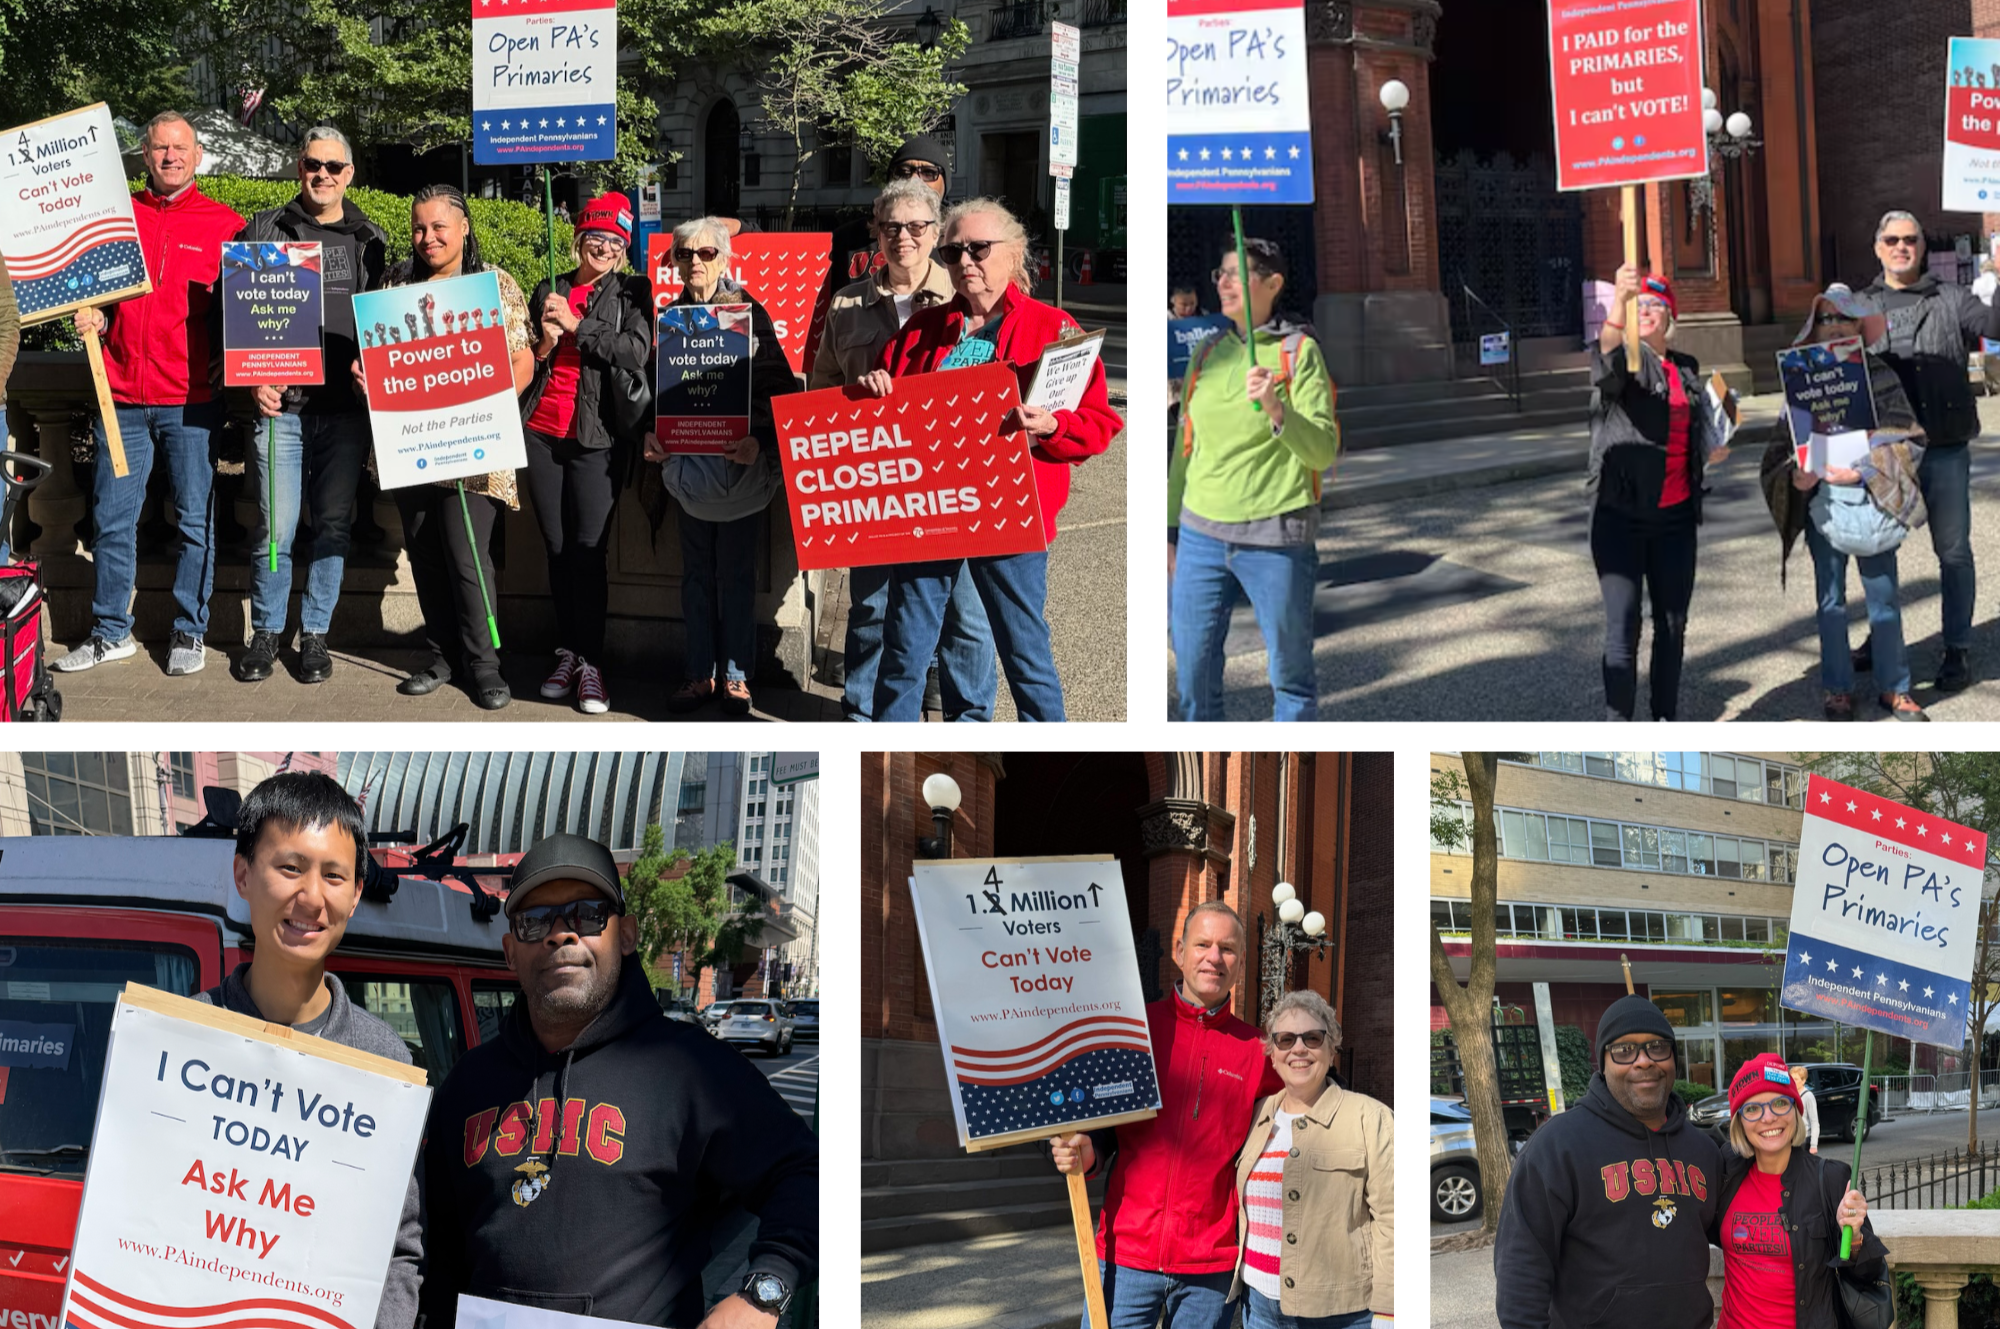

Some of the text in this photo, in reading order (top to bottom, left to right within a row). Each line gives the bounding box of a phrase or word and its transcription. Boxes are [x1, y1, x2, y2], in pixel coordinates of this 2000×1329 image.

[526, 17, 556, 25] Parties:
[489, 24, 600, 64] Open PA's
[1230, 28, 1285, 59] PA's
[1562, 20, 1688, 52] I PAID for the
[1570, 45, 1684, 75] PRIMARIES,
[493, 61, 592, 87] Primaries
[1611, 76, 1644, 95] but
[1167, 75, 1279, 105] Primaries
[1570, 95, 1689, 126] I can't VOTE!
[1961, 115, 1991, 131] the
[36, 135, 89, 160] Million
[490, 132, 598, 144] Independent Pennsylvanians
[32, 157, 72, 177] Voters
[18, 172, 95, 201] Can't Vote
[38, 195, 82, 215] Today
[12, 205, 117, 240] www.PAindependents.org
[251, 272, 296, 284] I can't
[236, 287, 310, 302] vote today
[250, 304, 297, 315] Ask me
[257, 318, 290, 331] why?
[388, 338, 483, 369] Power to
[683, 336, 724, 349] I can't
[241, 361, 308, 369] PENNSYLVANIANS
[669, 352, 738, 368] vote today
[1045, 357, 1088, 377] We Won't
[235, 370, 314, 378] www.PAindependents.org
[383, 361, 495, 395] the people
[681, 370, 724, 381] Ask me
[1045, 374, 1078, 389] Give up
[1805, 367, 1845, 385] I can't
[687, 384, 718, 398] why?
[1048, 388, 1066, 400] Our
[1795, 380, 1859, 401] vote today
[1810, 396, 1850, 412] Ask me
[401, 411, 493, 436] Not the Parties
[1818, 408, 1847, 424] why?
[397, 431, 502, 455] www.PAindependents.org
[789, 423, 912, 461] REPEAL
[795, 457, 923, 495] CLOSED
[800, 486, 981, 528] PRIMARIES
[775, 765, 787, 776] FEE
[789, 761, 807, 773] MUST
[1875, 839, 1913, 860] Parties:
[1822, 842, 1962, 908] Open PA's
[1011, 890, 1088, 913] Million
[1822, 883, 1949, 948] Primaries
[1002, 919, 1062, 937] Voters
[981, 945, 1093, 970] Can't Vote
[1009, 974, 1075, 994] Today
[1807, 974, 1947, 1020] Independent Pennsylvanians
[969, 1000, 1122, 1024] www.PAindependents.org
[1815, 991, 1929, 1030] www.PAindependents.org
[156, 1050, 377, 1139] I Can't Vote
[212, 1115, 310, 1164] TODAY
[464, 1097, 627, 1169] USMC
[181, 1159, 316, 1218] Ask Me
[1601, 1158, 1708, 1203] USMC
[1733, 1214, 1783, 1226] PEOPLE
[205, 1210, 281, 1260] Why
[1734, 1243, 1785, 1254] PARTIES!
[117, 1237, 346, 1309] www.PAindependents.org
